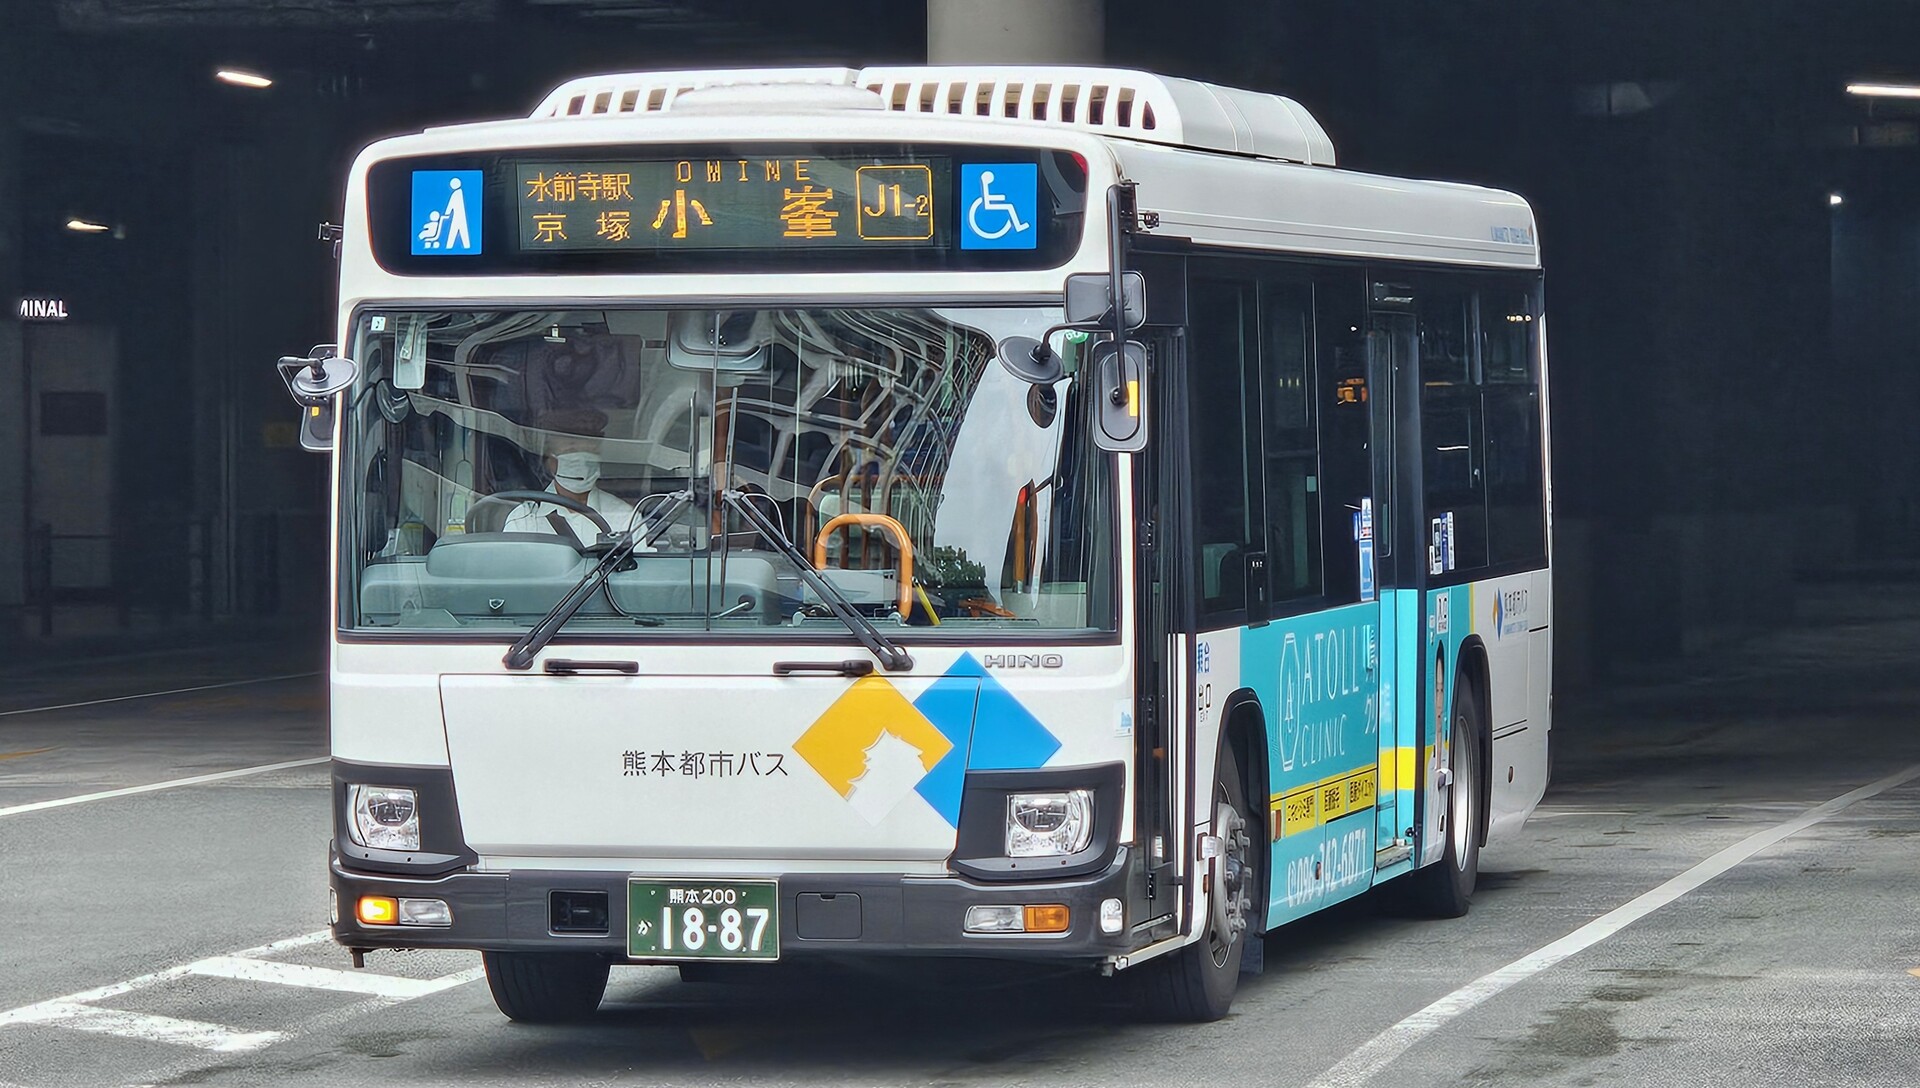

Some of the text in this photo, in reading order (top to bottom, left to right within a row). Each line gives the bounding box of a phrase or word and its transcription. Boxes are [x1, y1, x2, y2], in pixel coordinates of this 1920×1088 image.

[526, 172, 634, 202] 水前寺駅
[864, 184, 929, 217] J1-2
[984, 653, 1063, 668] HINO
[1302, 626, 1359, 705] ATOLL
[1302, 714, 1346, 767] CLINIC
[622, 750, 788, 779] 熊本都市バス
[1297, 828, 1366, 904] 096342-6871
[662, 907, 769, 951] 18-87
